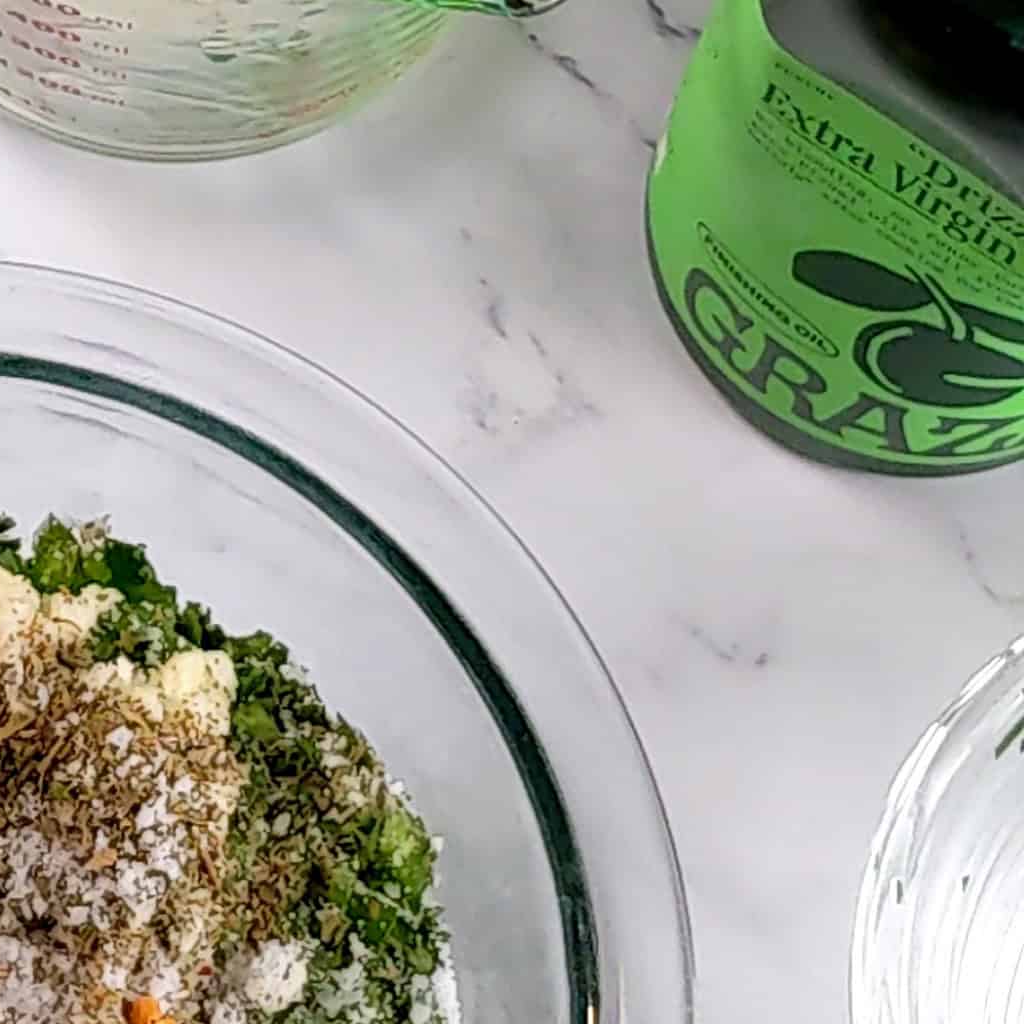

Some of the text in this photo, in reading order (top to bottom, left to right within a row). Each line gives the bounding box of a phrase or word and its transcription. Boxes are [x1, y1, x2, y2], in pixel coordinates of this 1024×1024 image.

[761, 82, 875, 174] Extra
[894, 159, 1017, 266] Virgin
[683, 267, 1024, 454] GRAZ
[793, 323, 828, 354] OIL
